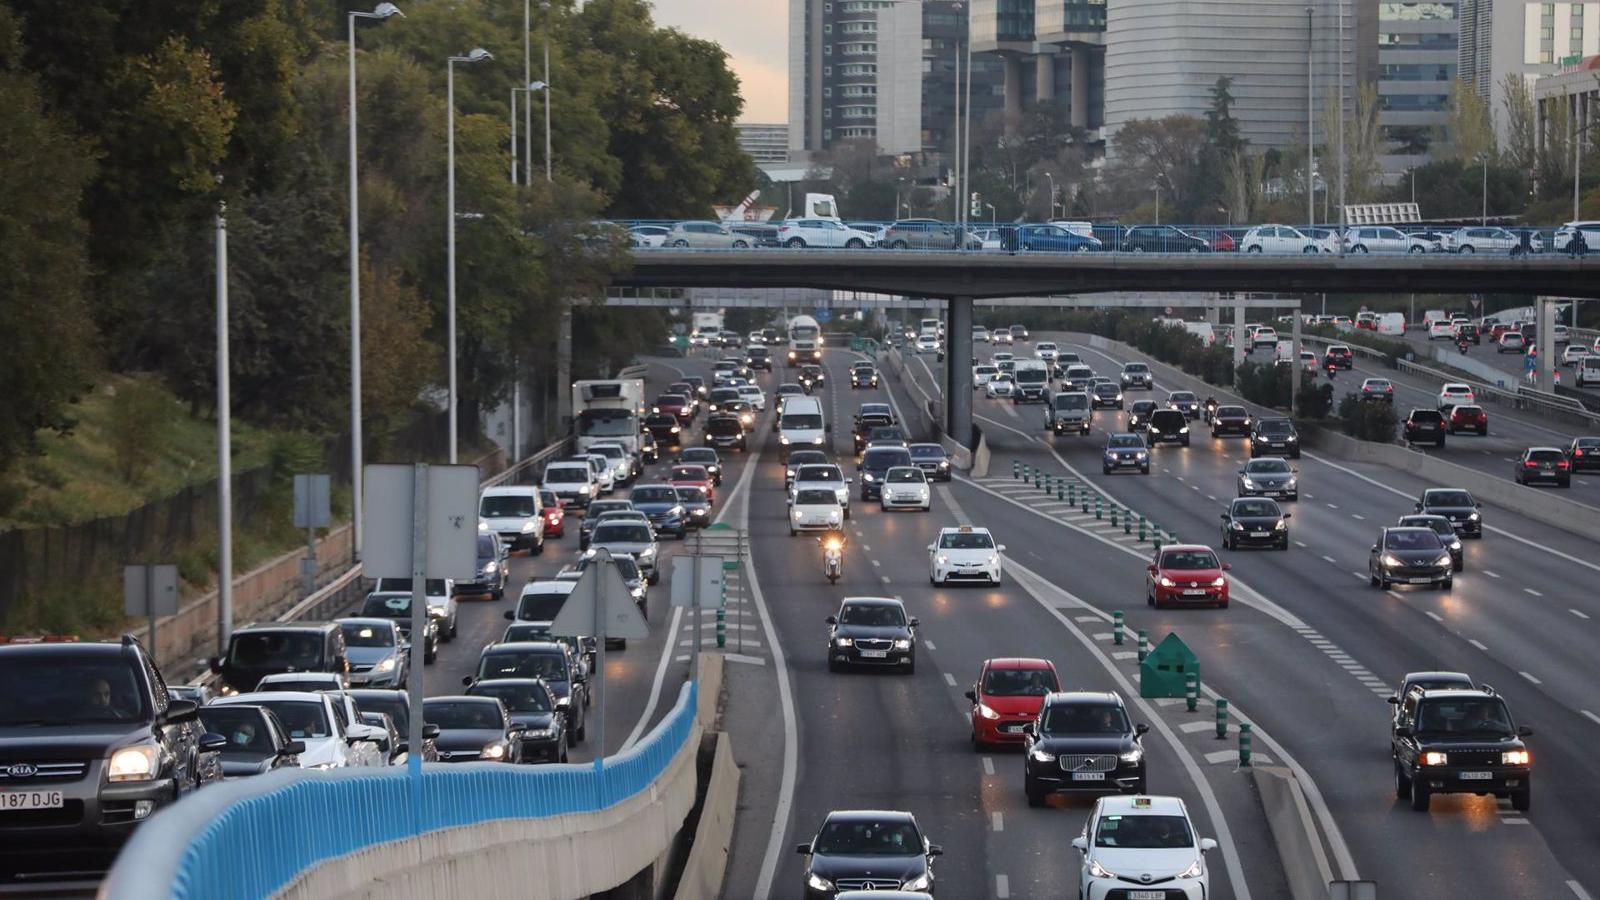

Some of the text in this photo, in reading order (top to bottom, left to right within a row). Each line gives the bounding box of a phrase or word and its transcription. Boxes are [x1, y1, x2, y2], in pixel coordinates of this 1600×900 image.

[12, 766, 32, 774] KIA
[1, 792, 60, 807] 187 DJG
